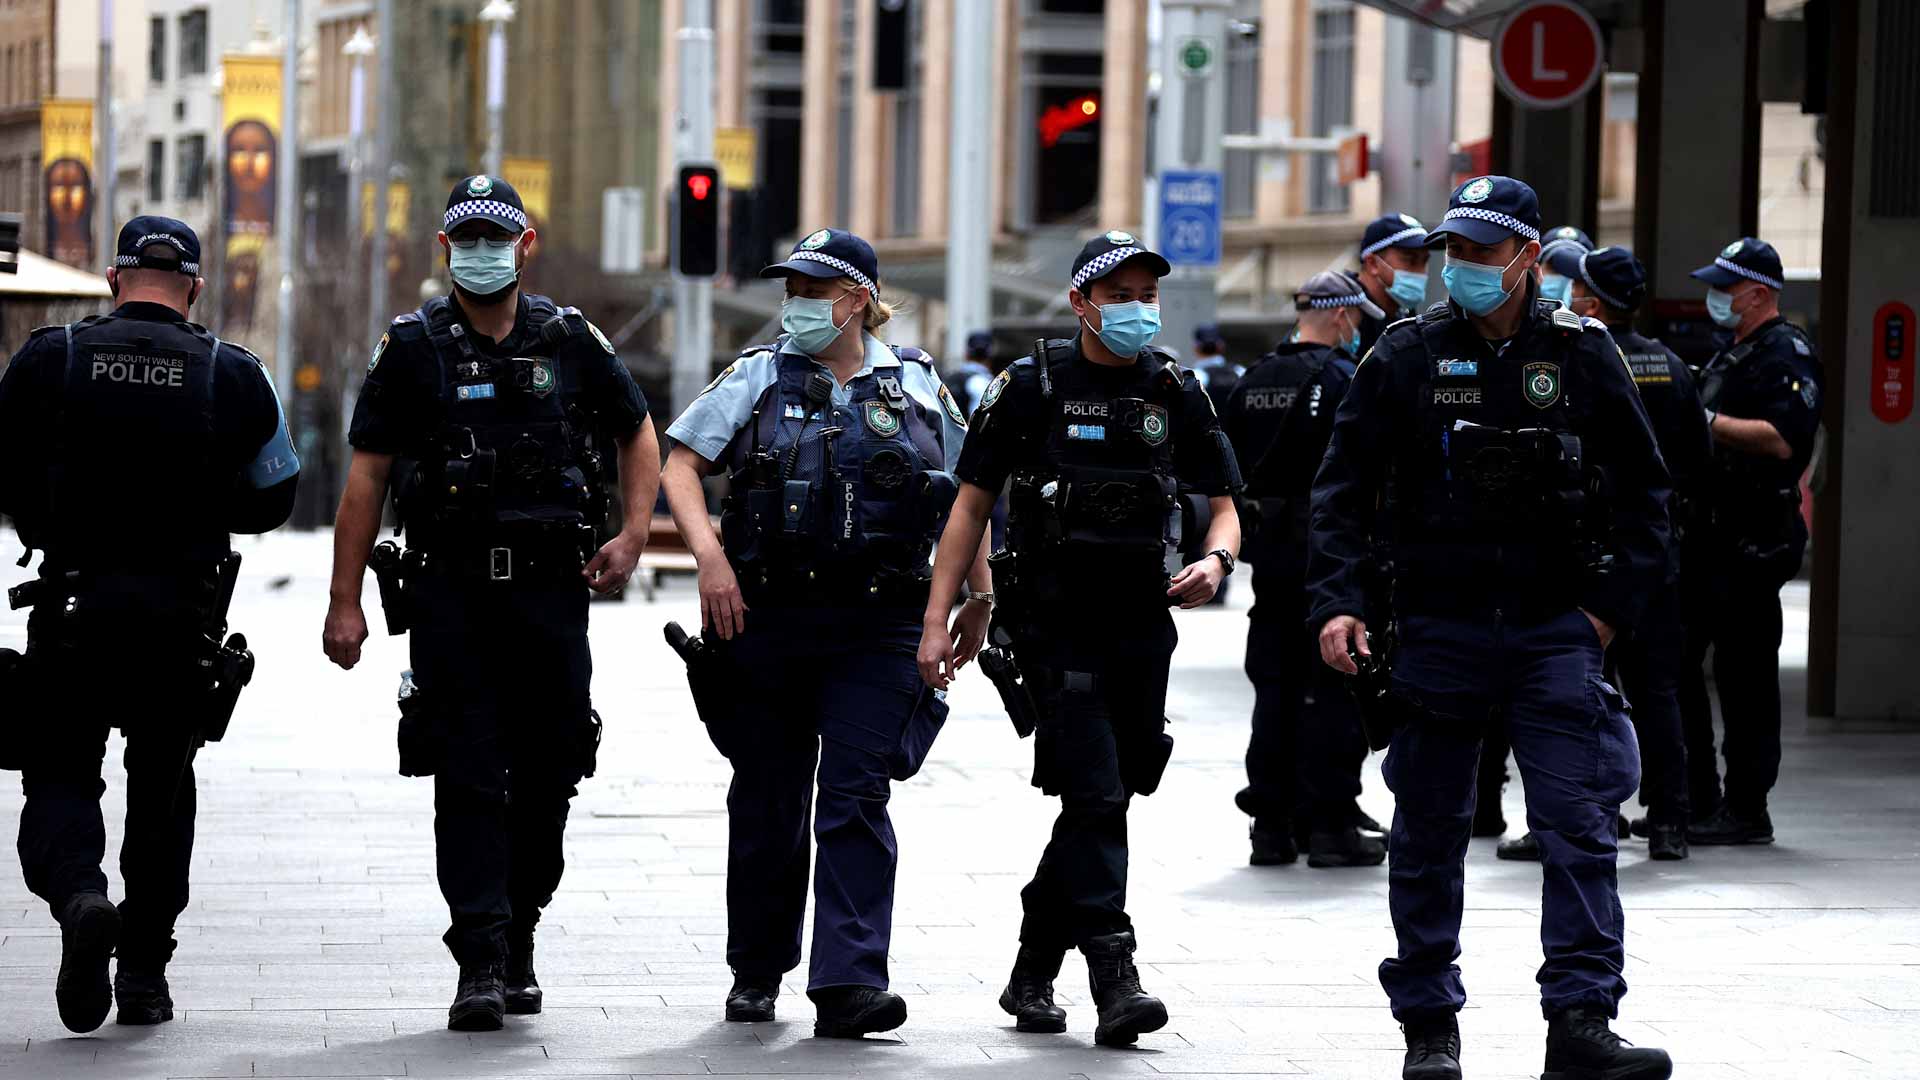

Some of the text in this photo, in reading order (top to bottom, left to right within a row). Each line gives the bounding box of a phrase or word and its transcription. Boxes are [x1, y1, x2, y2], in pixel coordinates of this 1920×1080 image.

[1532, 22, 1567, 80] L
[147, 233, 170, 241] POLICE
[93, 353, 184, 368] NEW SOUTH WALES
[91, 362, 184, 387] POLICE
[1246, 393, 1297, 409] POLICE
[1434, 393, 1481, 404] POLICE
[1064, 404, 1108, 417] POLICE
[262, 457, 286, 474] TL
[844, 482, 854, 539] POLICE
